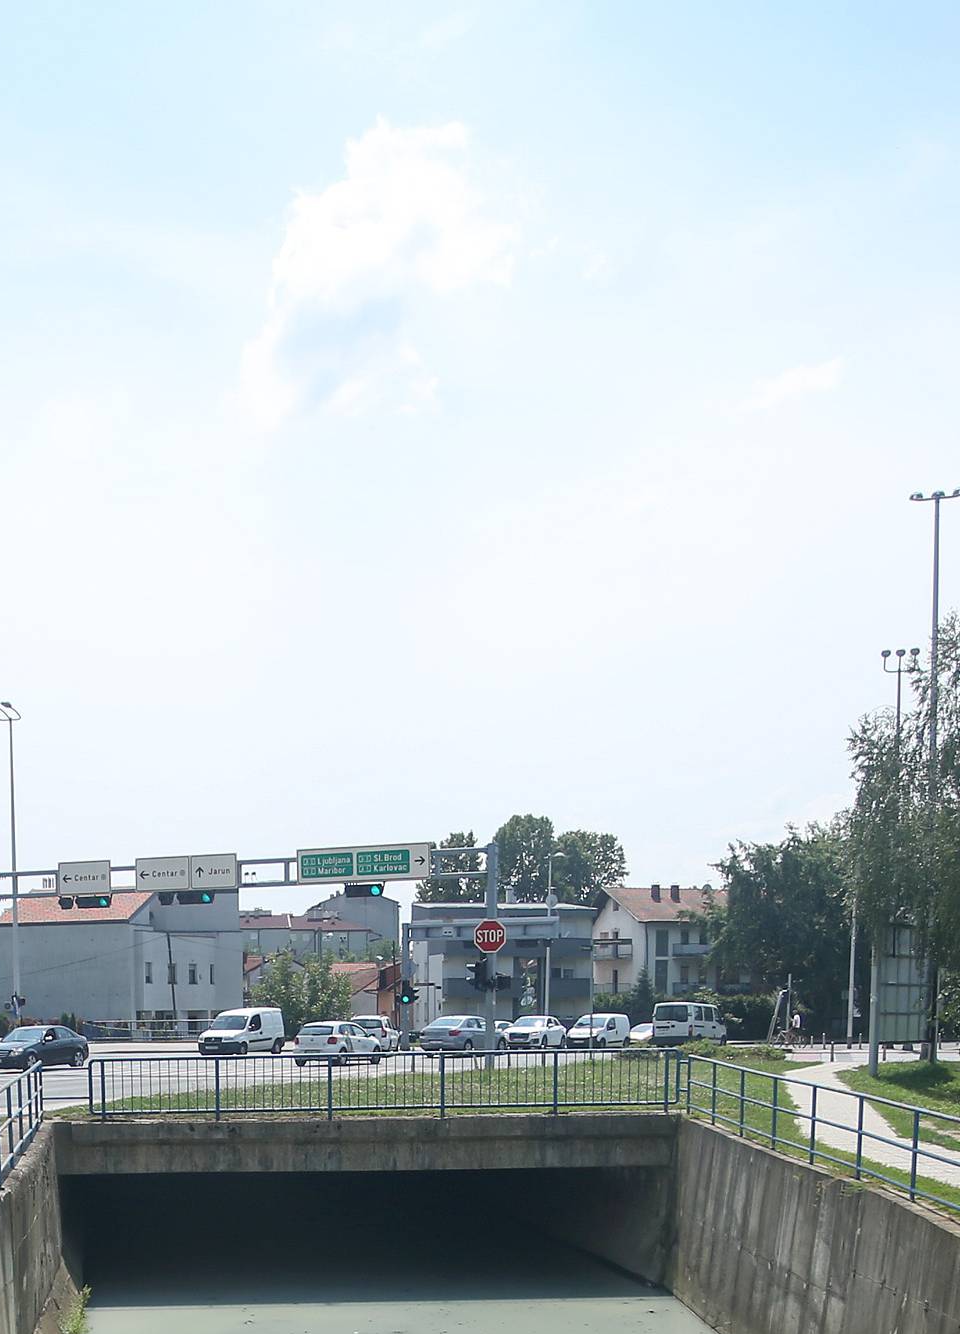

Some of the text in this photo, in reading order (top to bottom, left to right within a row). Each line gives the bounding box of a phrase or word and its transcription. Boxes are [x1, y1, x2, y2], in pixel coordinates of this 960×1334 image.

[384, 852, 402, 861] Brod
[317, 857, 351, 867] Ljubljana
[208, 867, 231, 876] Jarun
[317, 867, 346, 875] Maribor
[373, 864, 407, 872] Karlovac
[74, 874, 99, 882] Centar
[151, 870, 178, 878] Centar
[476, 929, 504, 943] STOP
